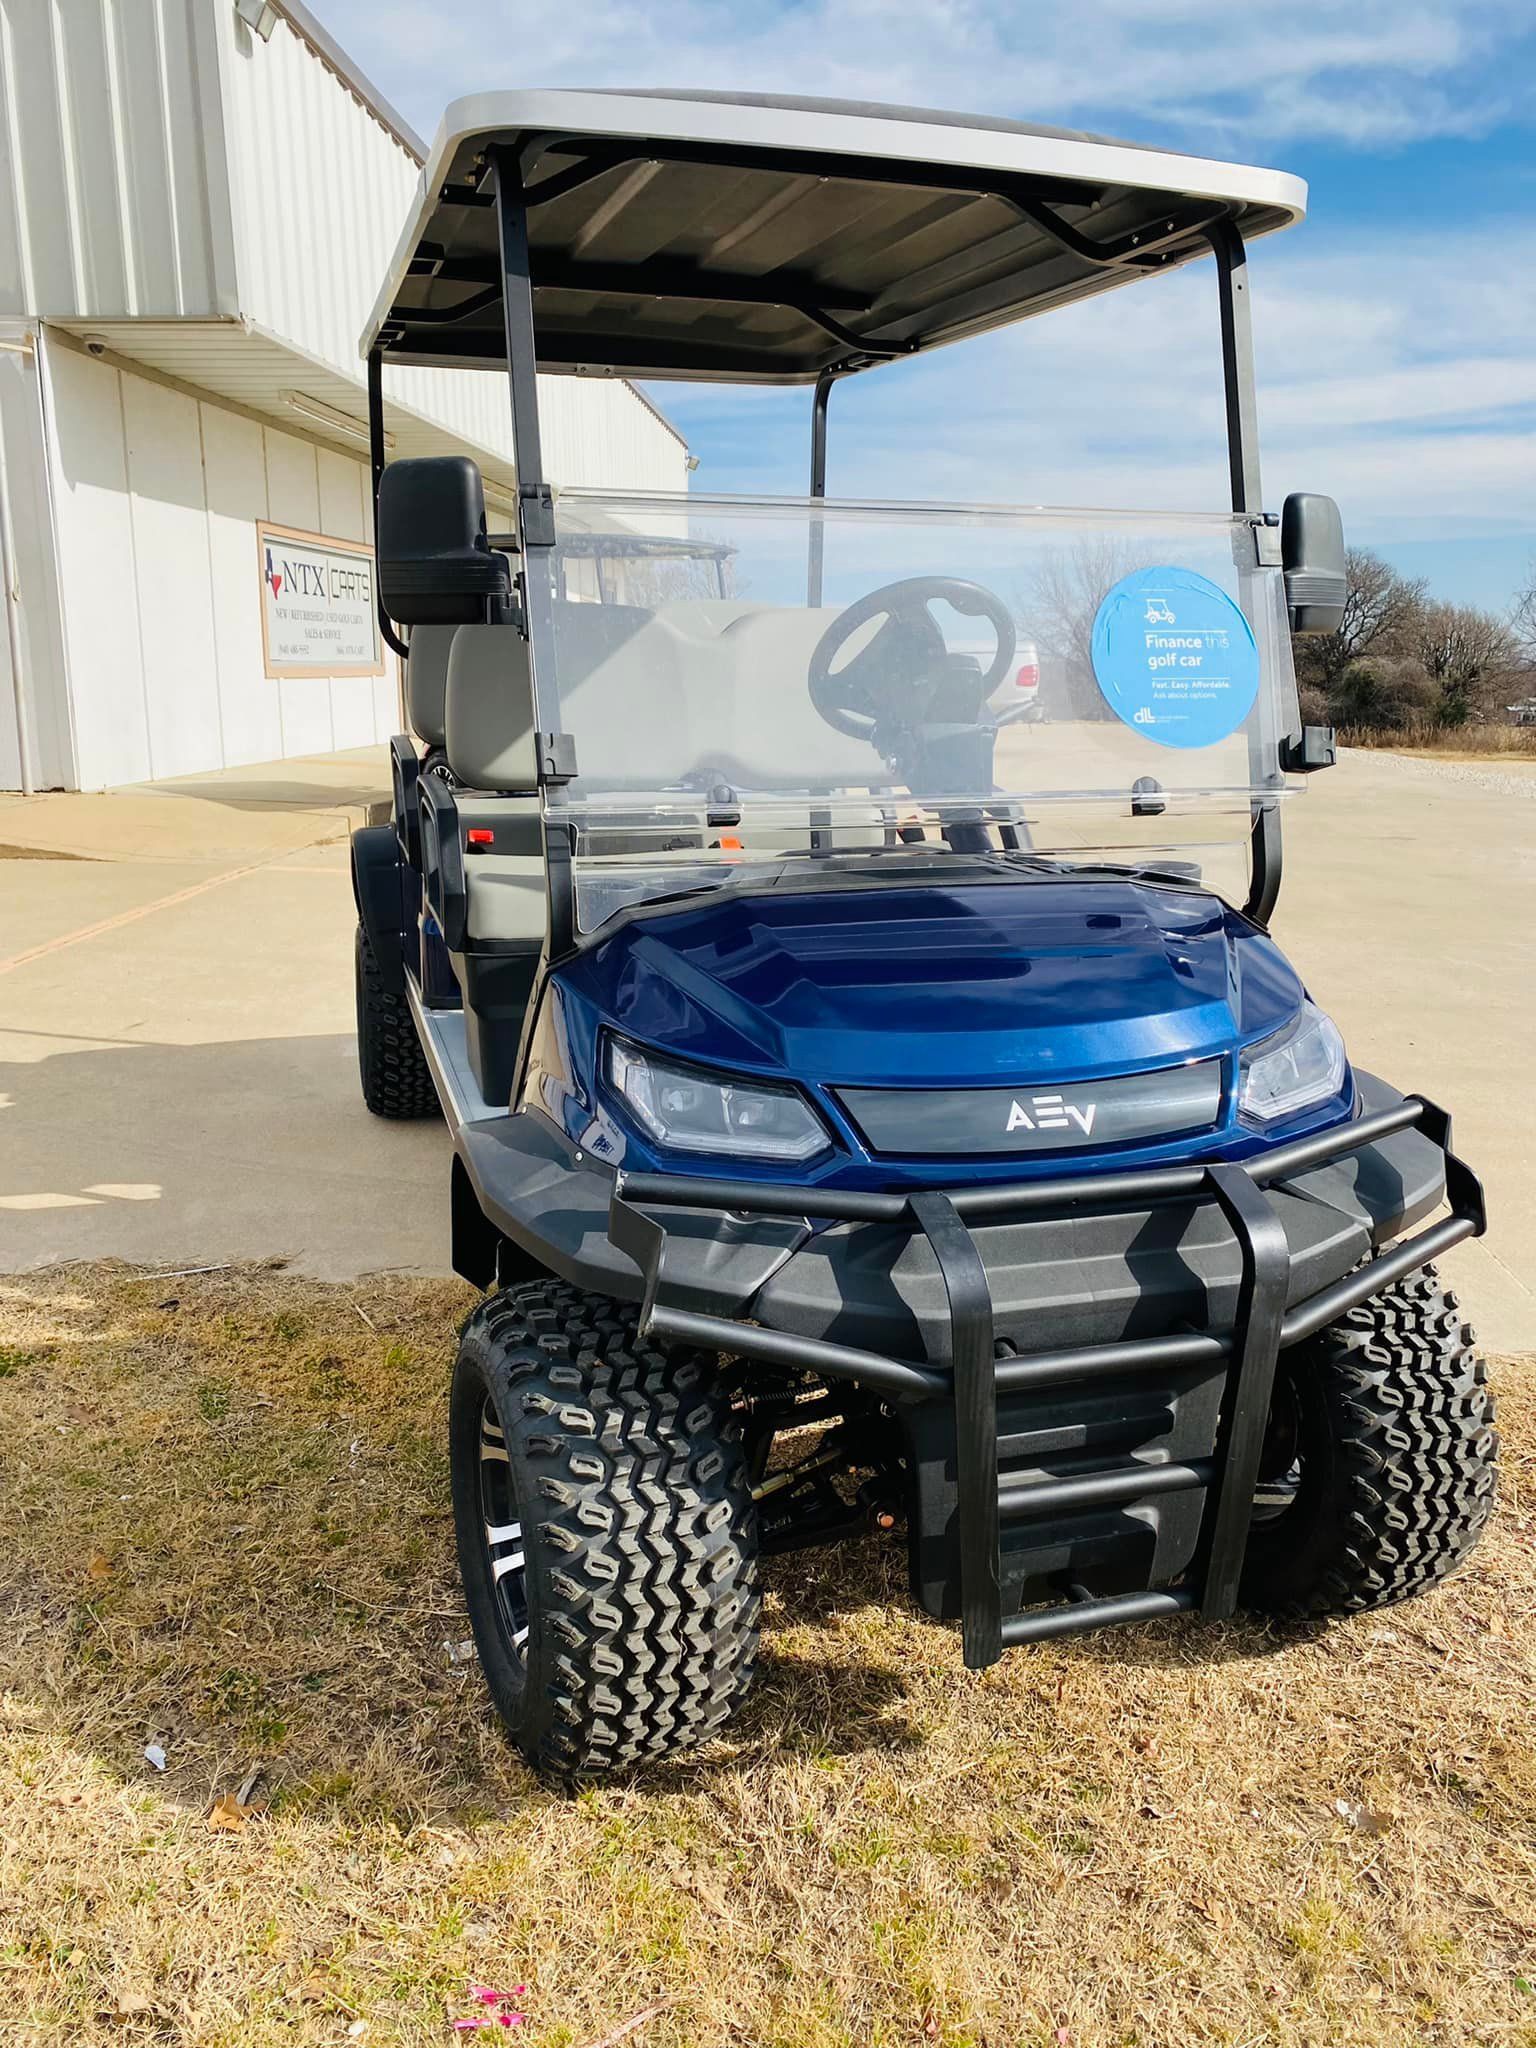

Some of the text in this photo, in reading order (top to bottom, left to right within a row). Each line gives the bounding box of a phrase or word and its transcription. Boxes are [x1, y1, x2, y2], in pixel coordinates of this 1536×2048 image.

[282, 560, 370, 602] NTX CARTS
[1145, 634, 1230, 649] Finance this
[1148, 652, 1203, 670] golf car
[1006, 1095, 1096, 1136] AEV
